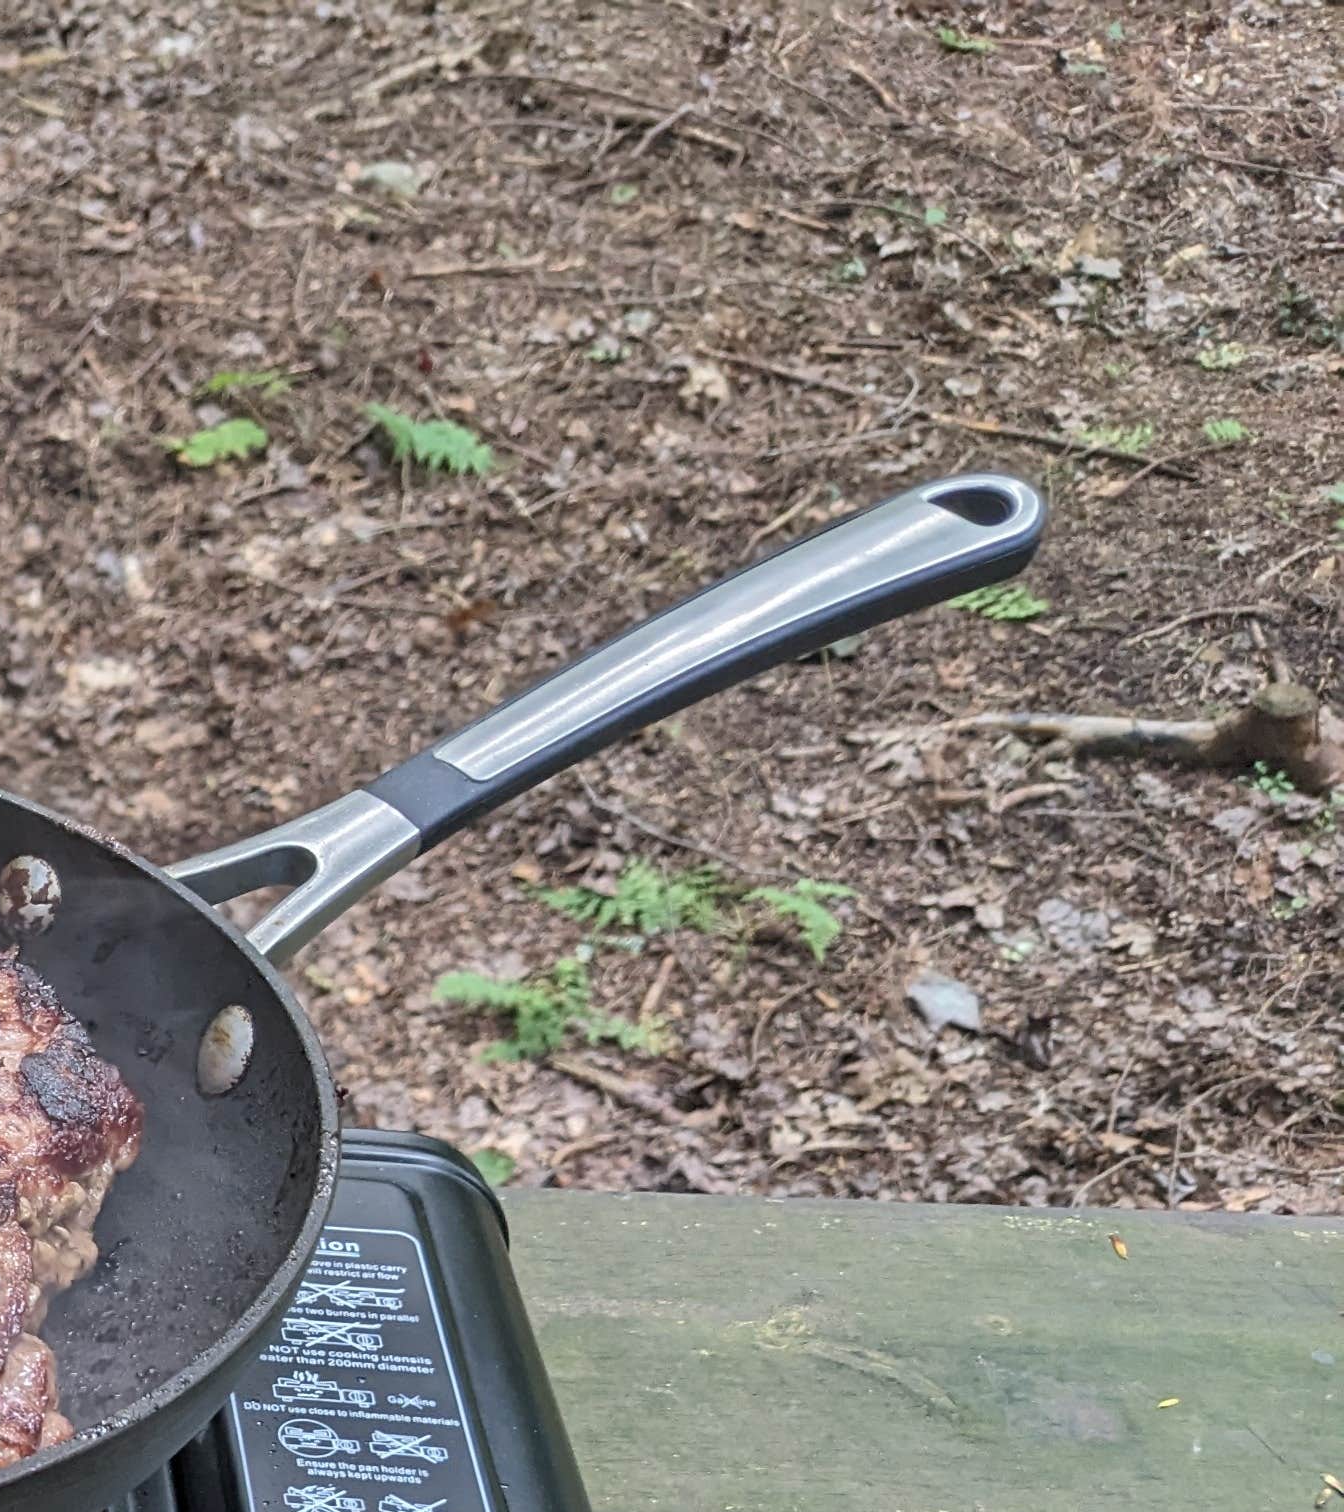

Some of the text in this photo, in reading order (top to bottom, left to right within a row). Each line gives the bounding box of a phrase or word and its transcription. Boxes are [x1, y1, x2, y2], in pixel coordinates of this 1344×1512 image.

[324, 1269, 360, 1278] restrict
[362, 1271, 375, 1279] air
[377, 1272, 399, 1280] flow
[345, 1261, 378, 1271] plastic
[380, 1264, 407, 1273] carry
[306, 1308, 324, 1316] two
[326, 1309, 366, 1318] burners
[380, 1312, 419, 1322] parallel
[270, 1344, 432, 1365] NOT use cooking utensils
[296, 1355, 325, 1366] than
[328, 1358, 376, 1369] 200mm
[378, 1361, 435, 1374] diameter
[244, 1401, 261, 1411] DO
[263, 1404, 286, 1412] NOT
[289, 1406, 306, 1414] use
[309, 1407, 335, 1416] close
[350, 1410, 411, 1422] inflammable
[413, 1415, 460, 1426] materials
[296, 1458, 336, 1468] Ensure
[338, 1461, 356, 1470] the
[359, 1464, 380, 1472] pan
[382, 1465, 416, 1475] holder
[308, 1468, 421, 1484] always kept upwards
